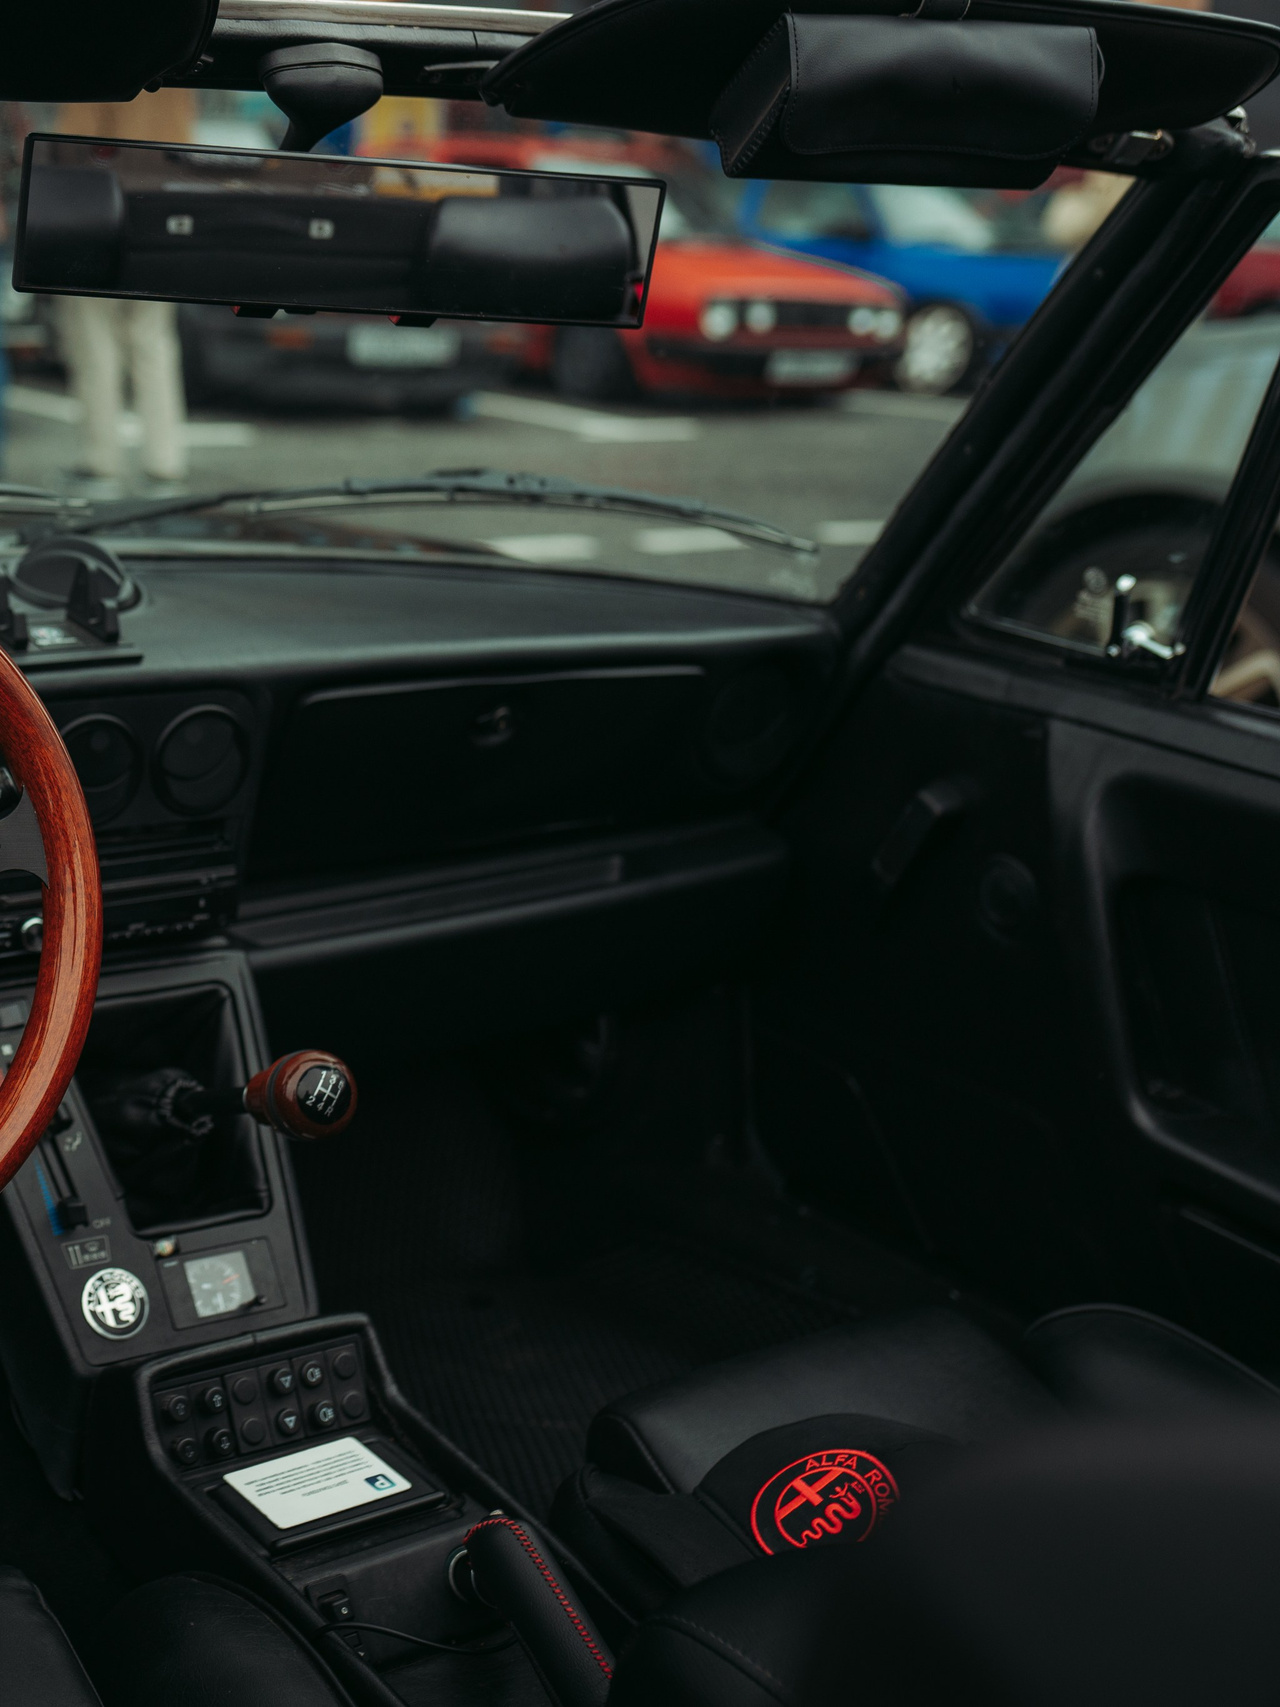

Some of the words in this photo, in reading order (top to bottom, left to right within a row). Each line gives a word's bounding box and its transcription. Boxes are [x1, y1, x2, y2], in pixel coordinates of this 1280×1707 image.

[320, 1070, 327, 1080] 1
[305, 1095, 316, 1107] 2
[317, 1102, 325, 1112] 4
[324, 1106, 334, 1118] R
[92, 1218, 111, 1229] OFF
[805, 1454, 858, 1472] ALFA
[864, 1468, 895, 1522] ROM
